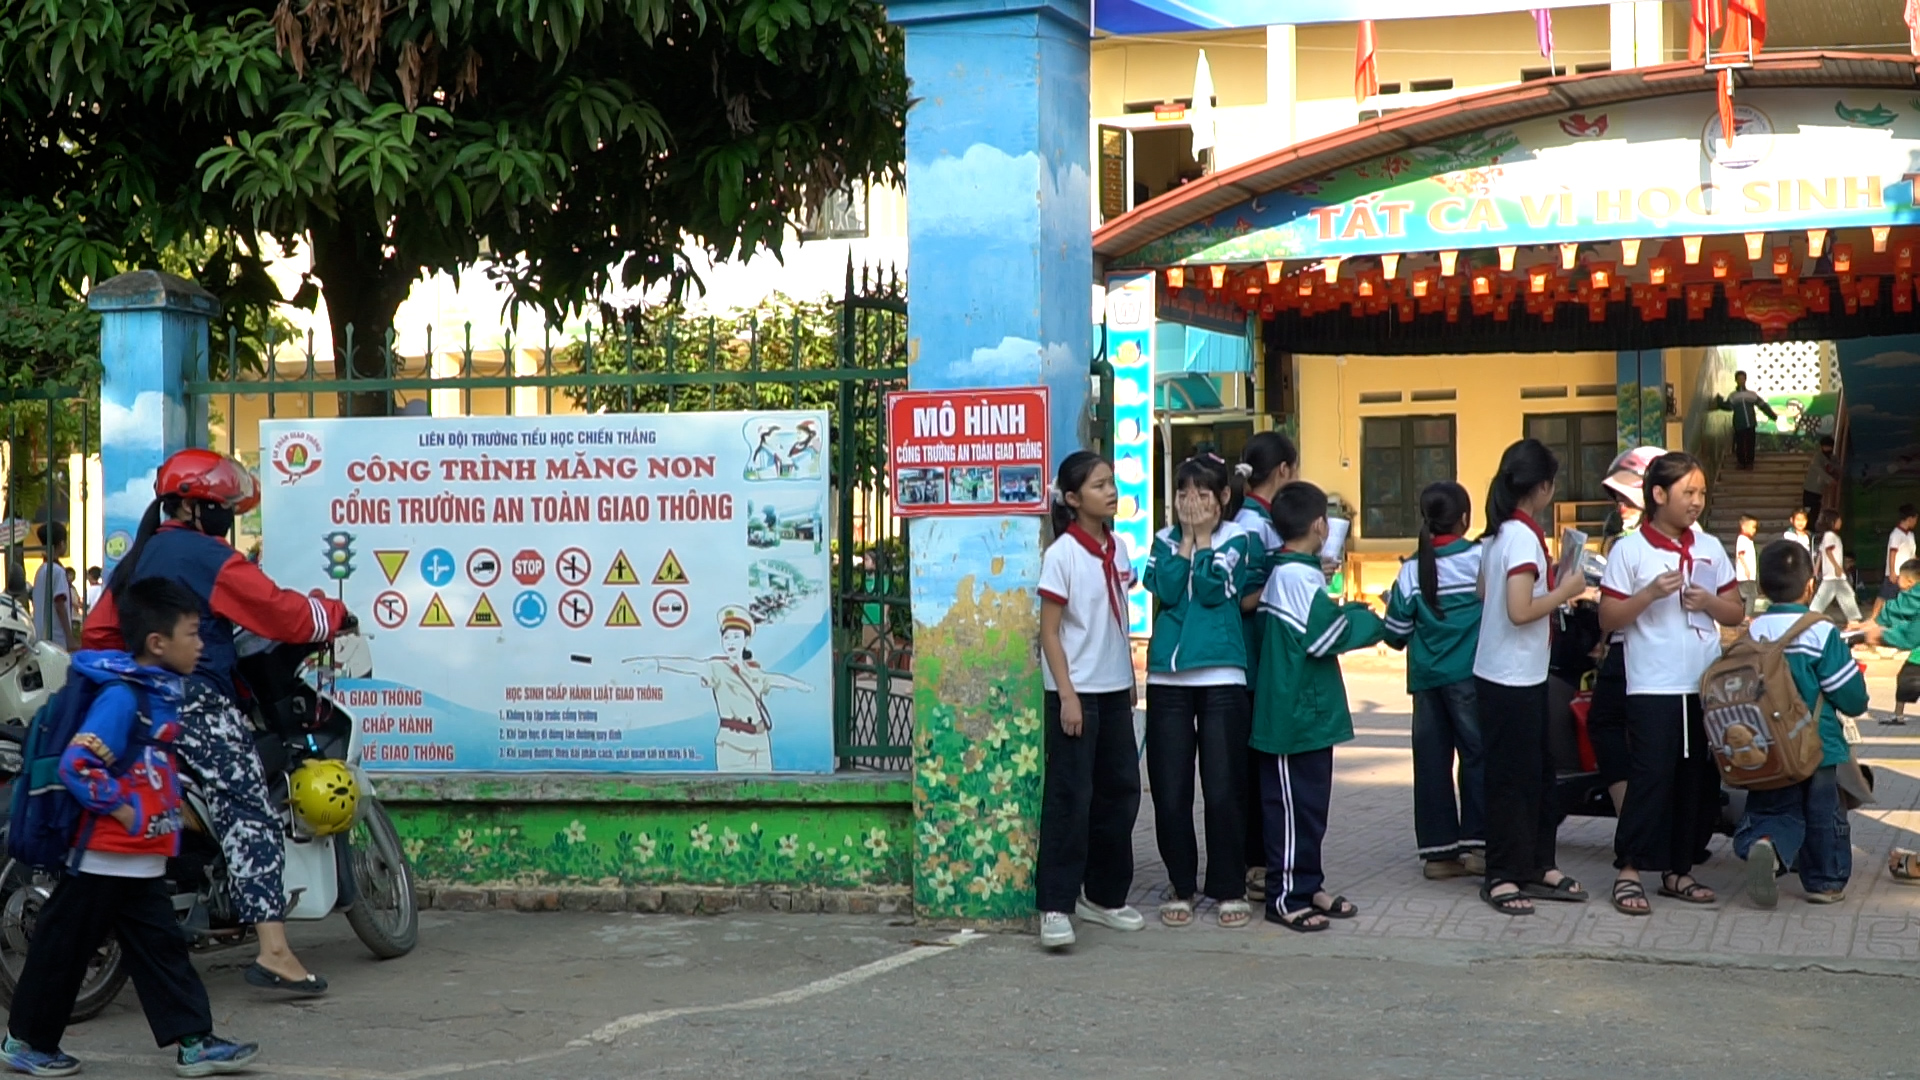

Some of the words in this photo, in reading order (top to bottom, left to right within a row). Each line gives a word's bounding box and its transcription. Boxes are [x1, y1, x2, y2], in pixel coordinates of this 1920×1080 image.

[1310, 194, 1413, 240] TẤT
[1428, 187, 1507, 232] CẢ
[1521, 186, 1577, 226] VÌ
[1596, 183, 1720, 227] HỌC
[1743, 175, 1884, 214] SINH
[913, 400, 956, 438] MÔ
[964, 399, 1026, 437] HÌNH
[419, 430, 445, 447] LIÊN
[449, 431, 468, 449] ĐỘI
[471, 429, 518, 447] TRƯỜNG
[521, 427, 547, 446] TIỂU
[550, 431, 574, 449] HỌC
[896, 439, 921, 463] CỔNG
[922, 440, 956, 463] TRƯỜNG
[957, 443, 970, 462] AN
[971, 440, 994, 462] TOÀN
[995, 442, 1014, 460] GIAO
[1015, 438, 1042, 460] THÔNG
[347, 455, 431, 482] CÔNG
[440, 453, 536, 481] TRÌNH
[545, 451, 638, 480] MĂNG
[647, 456, 716, 479] NON
[331, 488, 391, 524] CỔNG
[398, 490, 485, 524] TRƯỜNG
[492, 498, 523, 523] AN
[530, 491, 589, 523] TOÀN
[598, 496, 650, 522] GIAO
[657, 489, 733, 521] THÔNG
[515, 560, 541, 575] STOP
[350, 690, 378, 706] GIAO
[381, 686, 422, 706] THÔNG
[505, 687, 522, 703] HỌC
[524, 687, 544, 700] SINH
[546, 682, 567, 700] CHẤP
[569, 684, 592, 700] HÀNH
[594, 684, 613, 704] LUẬT
[615, 687, 635, 700] GIAO
[636, 684, 663, 700] THÔNG
[363, 711, 395, 734] CHẤP
[399, 714, 433, 733] HÀNH
[382, 745, 409, 761] GIAO
[413, 741, 454, 761] THÔNG
